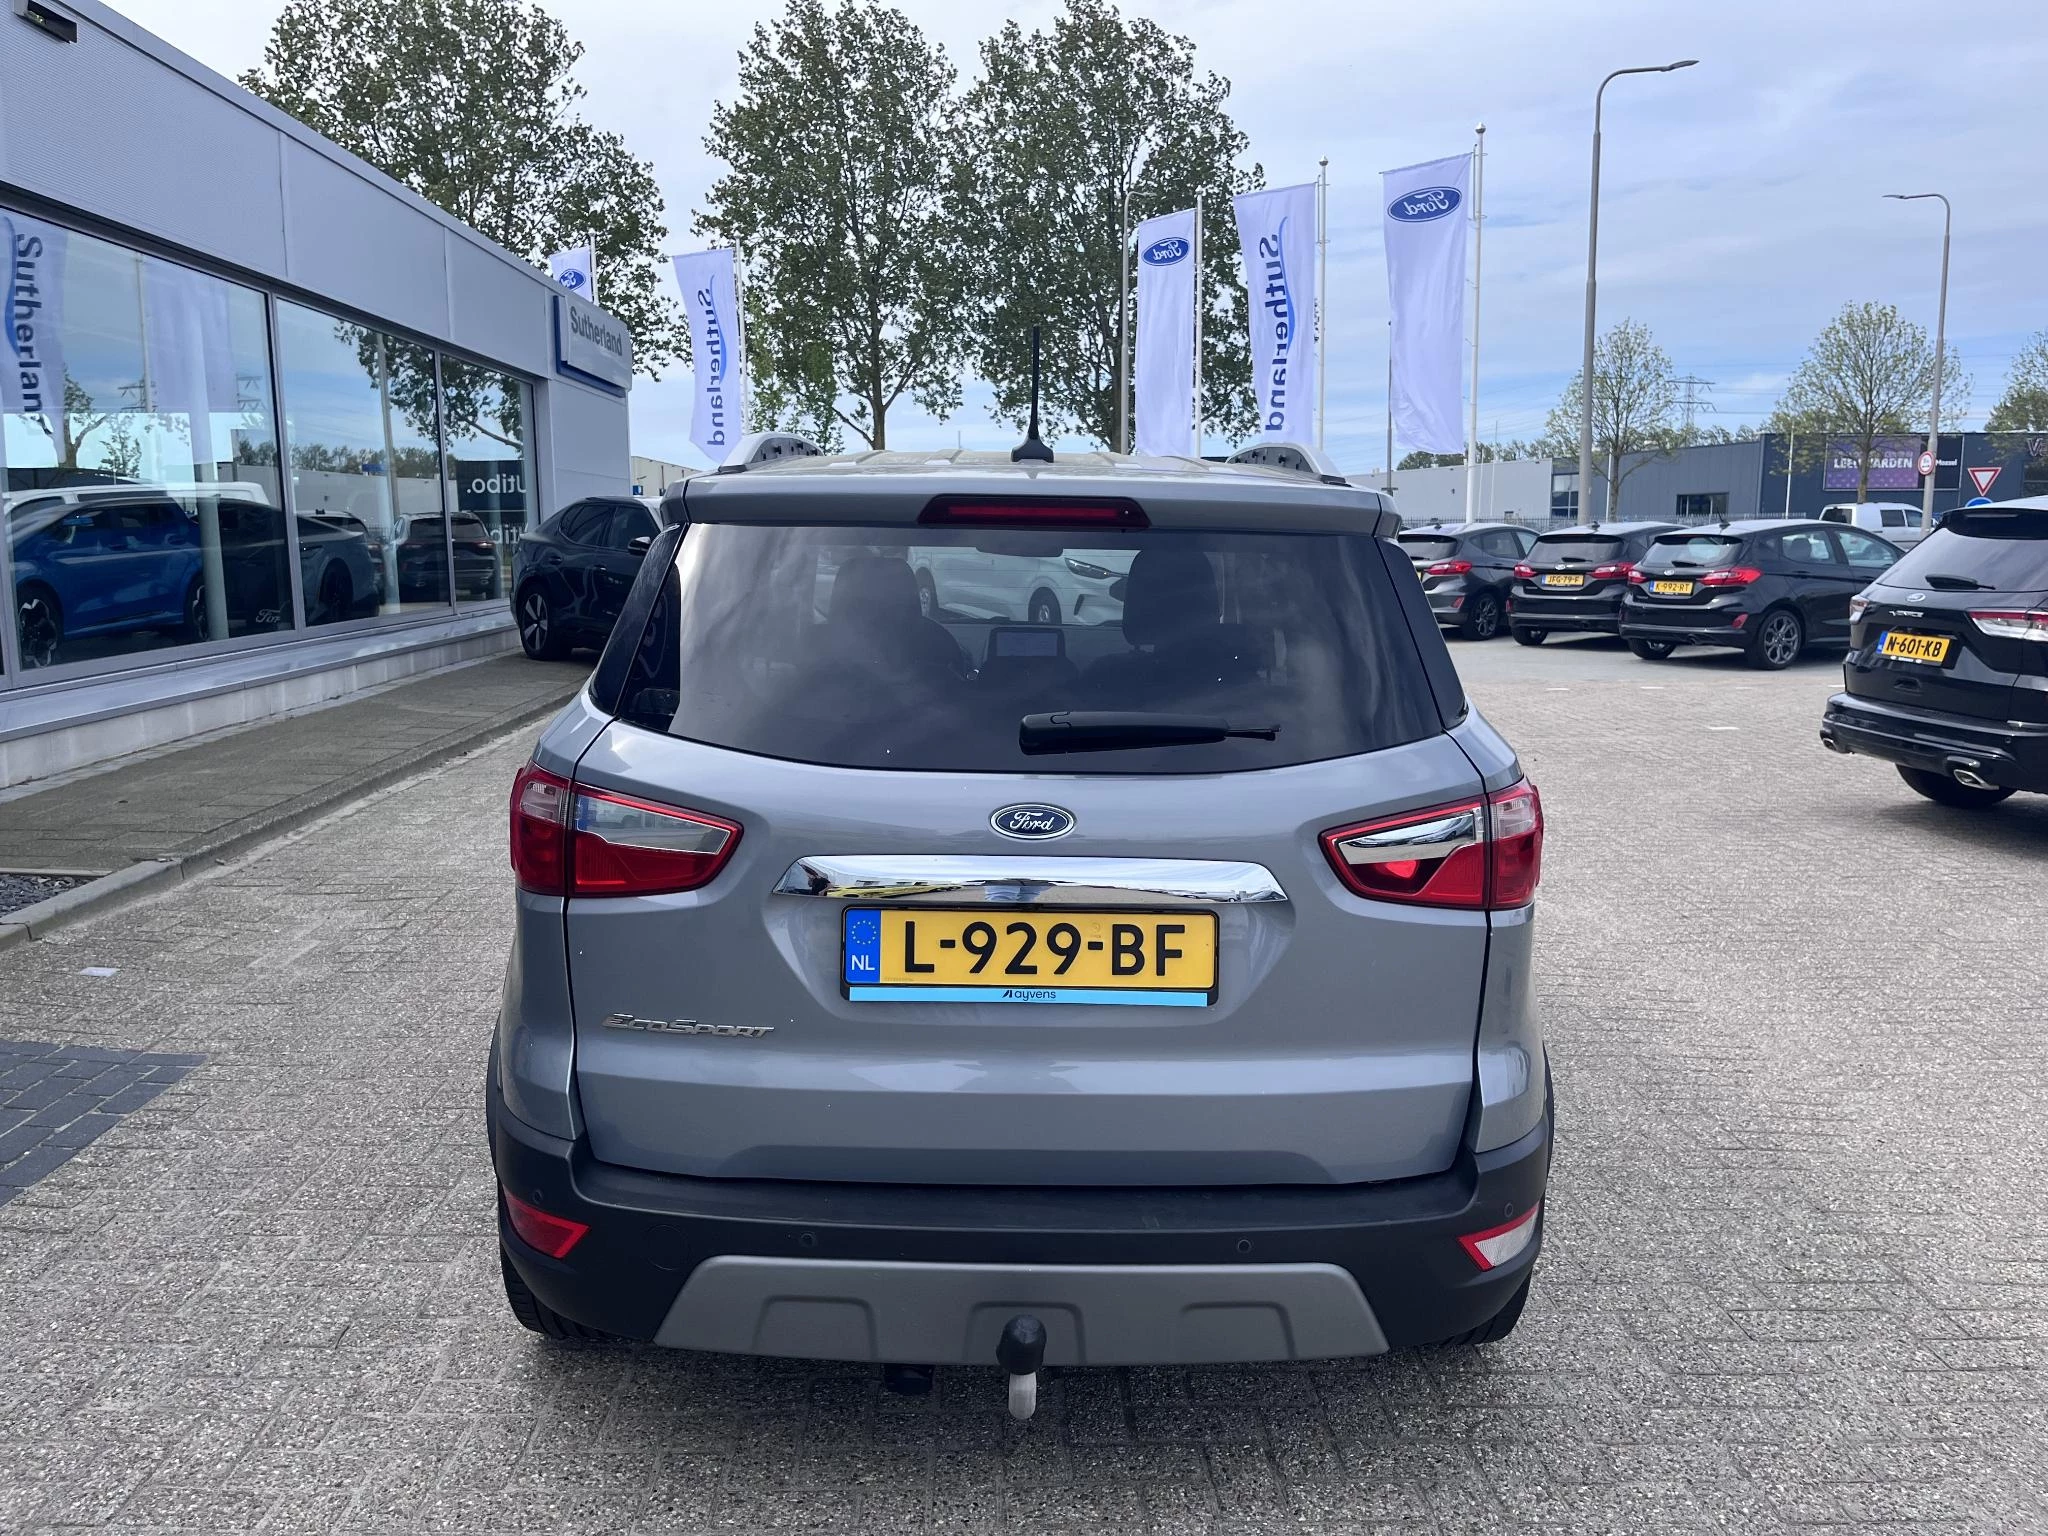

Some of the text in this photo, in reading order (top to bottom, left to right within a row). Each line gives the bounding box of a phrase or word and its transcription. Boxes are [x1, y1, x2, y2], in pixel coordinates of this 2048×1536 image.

[15, 233, 43, 413] Sutherlan
[570, 306, 622, 356] Sutherland
[1834, 458, 1913, 469] LEEARDEN
[1655, 583, 1690, 593] K-992-RT
[1886, 636, 1943, 658] N-601-KB
[1010, 811, 1055, 830] Ford
[905, 920, 1186, 977] L-929-BF
[851, 954, 875, 971] NL
[1013, 988, 1056, 1001] ayvens
